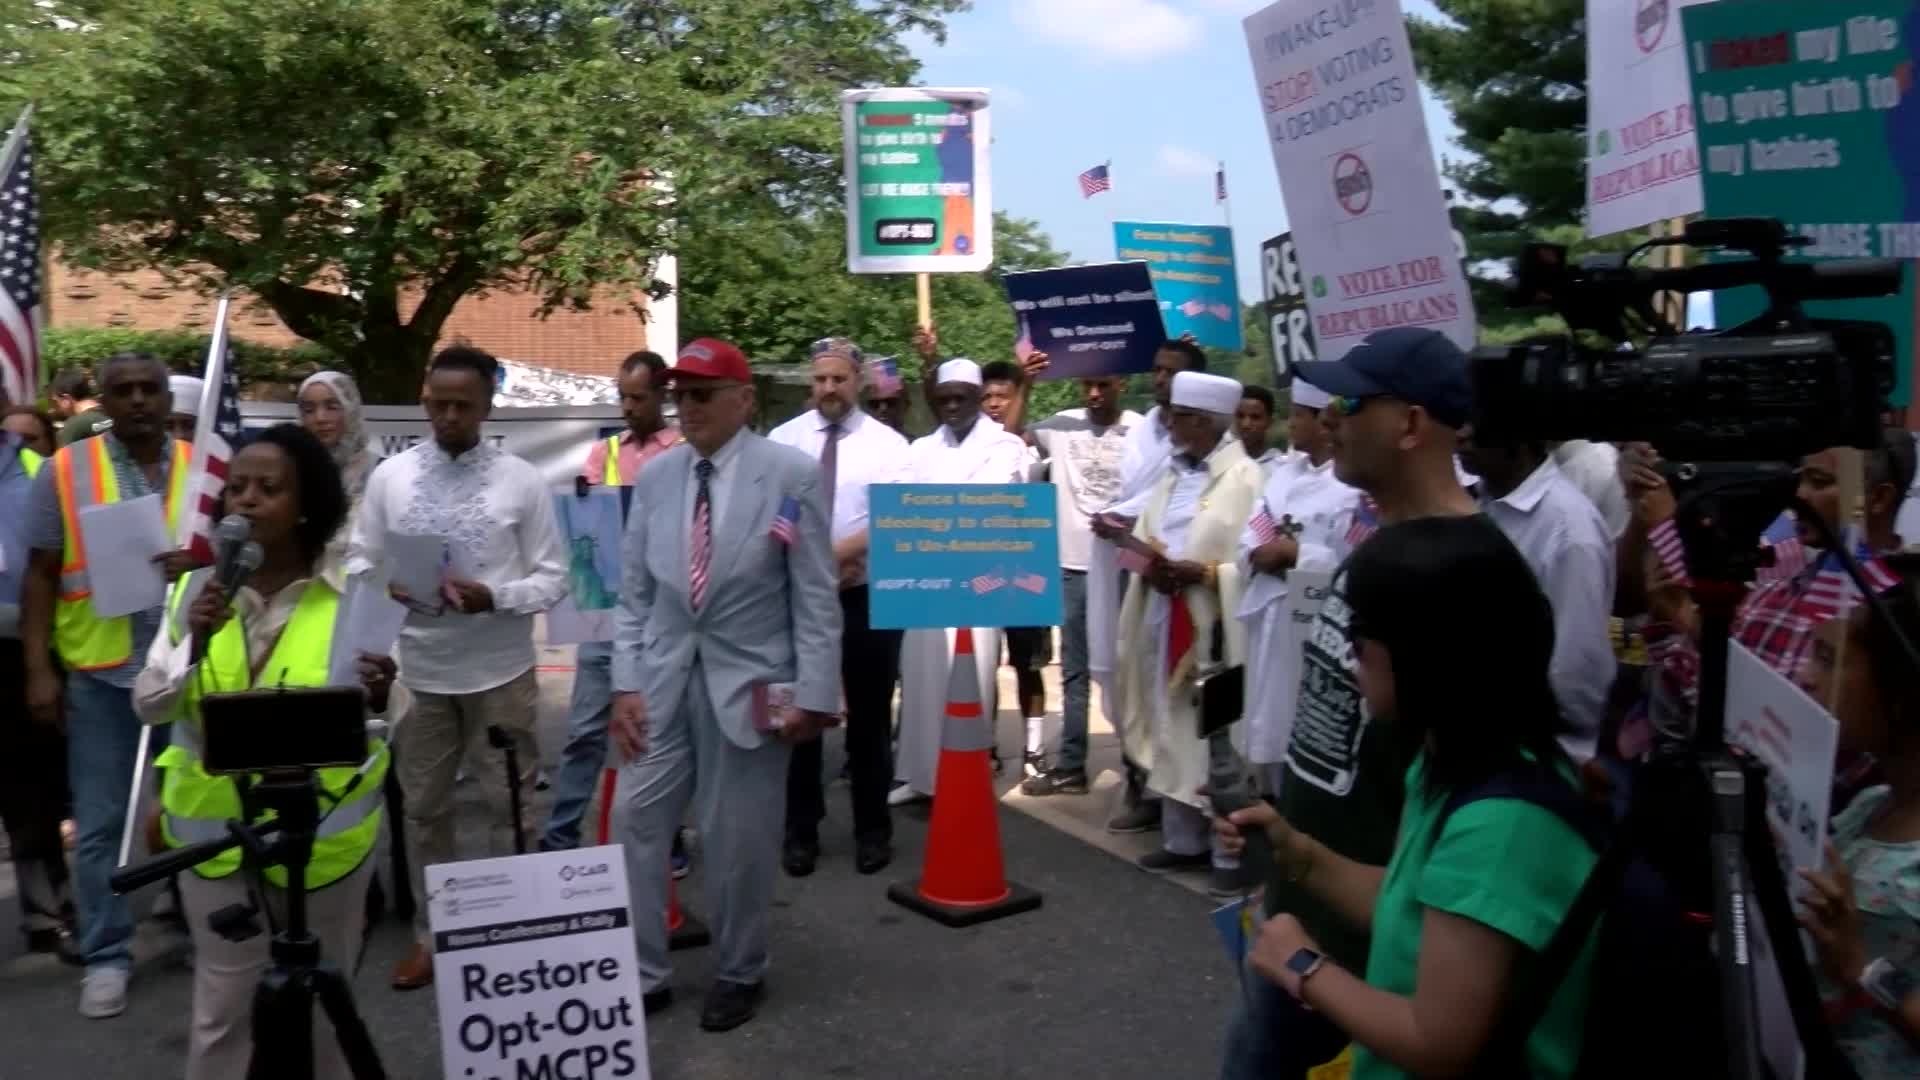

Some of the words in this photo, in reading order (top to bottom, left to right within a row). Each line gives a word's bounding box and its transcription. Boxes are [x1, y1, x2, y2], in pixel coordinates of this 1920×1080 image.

[1794, 26, 1839, 63] my
[1845, 15, 1898, 55] life
[1317, 36, 1394, 86] VOTING
[1286, 76, 1405, 142] DEMOCRATS
[1701, 90, 1728, 124] to
[1731, 84, 1787, 125] give
[1791, 77, 1861, 117] birth
[1866, 73, 1900, 109] to
[1620, 109, 1668, 151] VOTE
[1593, 147, 1701, 201] REPUBLICA
[1707, 143, 1745, 176] my
[1749, 133, 1841, 171] babies
[1337, 265, 1396, 297] VOTE
[1397, 255, 1444, 286] FOR
[1011, 300, 1037, 311] We
[1038, 295, 1065, 308] will
[1065, 295, 1092, 306] not
[1092, 292, 1113, 304] be
[1317, 292, 1459, 338] REPUBLICANS
[1050, 326, 1075, 338] We
[1075, 320, 1136, 336] Demand
[901, 493, 954, 506] Force
[957, 492, 1027, 508] feeding
[875, 516, 950, 532] ideology
[957, 517, 977, 529] to
[981, 516, 1053, 529] citizens
[895, 540, 913, 552] is
[916, 539, 1035, 553] Un-American
[874, 578, 953, 591] #OPT-OUT
[576, 863, 609, 877] CAIR
[488, 921, 567, 941] Conference
[580, 913, 616, 930] Rally
[461, 957, 619, 1002] Restore
[459, 996, 634, 1060] Opt-Out
[516, 1039, 636, 1080] MCPS
